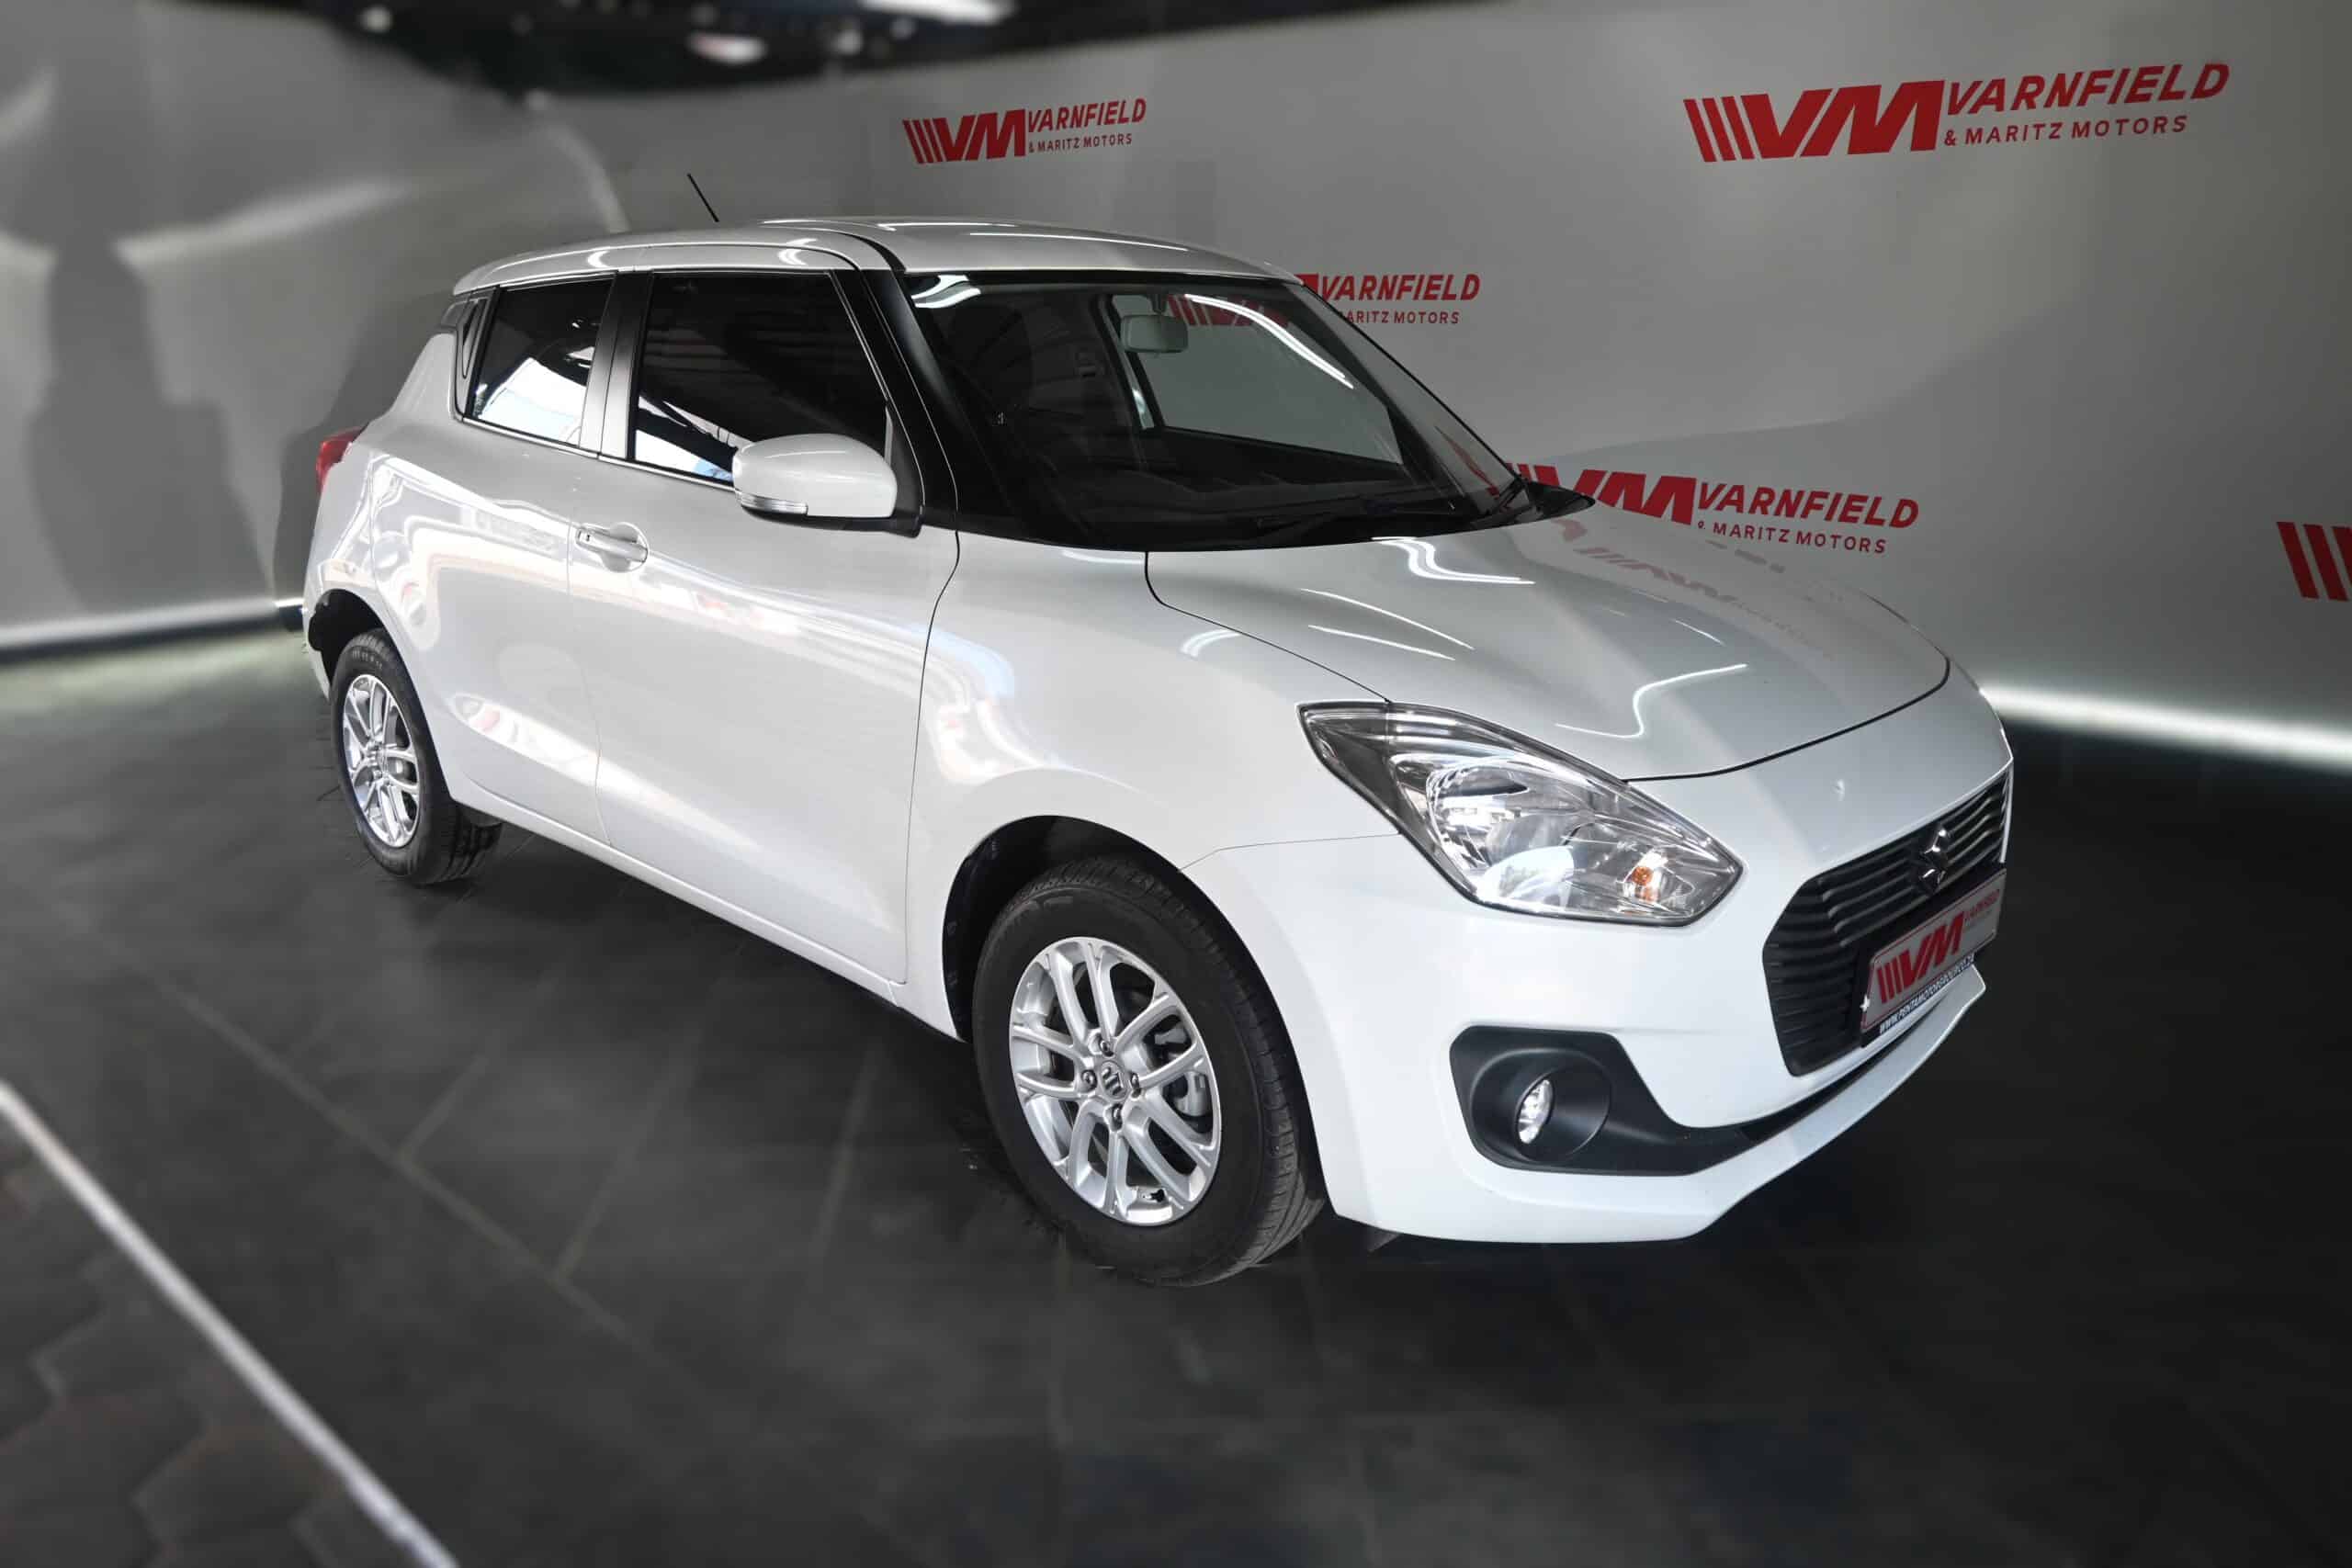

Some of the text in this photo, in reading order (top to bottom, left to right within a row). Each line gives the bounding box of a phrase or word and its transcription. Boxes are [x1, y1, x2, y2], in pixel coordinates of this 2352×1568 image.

[1740, 62, 2230, 159] VM VARNFIELD
[931, 97, 1148, 163] VM VARNFIELD
[1037, 137, 1080, 152] MARITZ
[1083, 133, 1133, 148] MOTORS
[1944, 115, 2189, 147] & MARITZ MOTORS
[1321, 273, 1480, 301] VARNFIELD
[1346, 310, 1460, 324] ARITZ MOTORS
[1698, 482, 1919, 529] VARNFIELD
[1713, 522, 1790, 544] MARITZ
[1796, 531, 1887, 554] MOTORS
